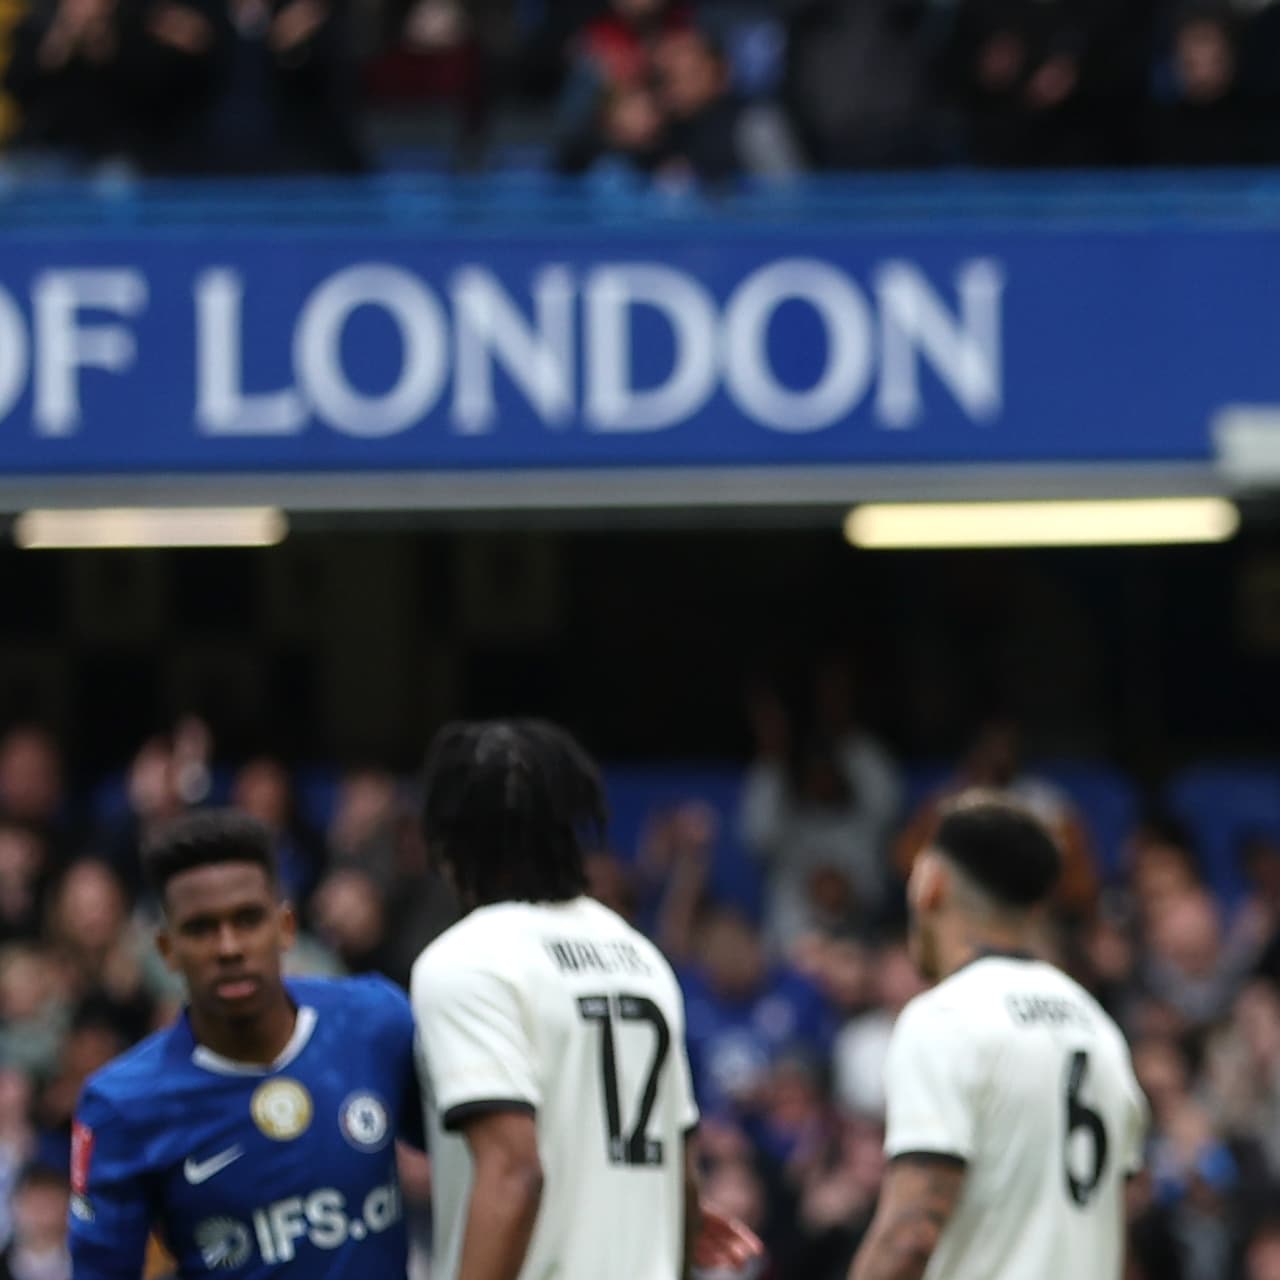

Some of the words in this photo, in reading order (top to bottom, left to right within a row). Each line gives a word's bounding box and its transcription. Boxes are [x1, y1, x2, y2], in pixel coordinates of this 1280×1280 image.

[0, 264, 148, 438] F
[196, 256, 1005, 438] LONDON
[577, 995, 671, 1168] 12
[1060, 1050, 1108, 1210] 6
